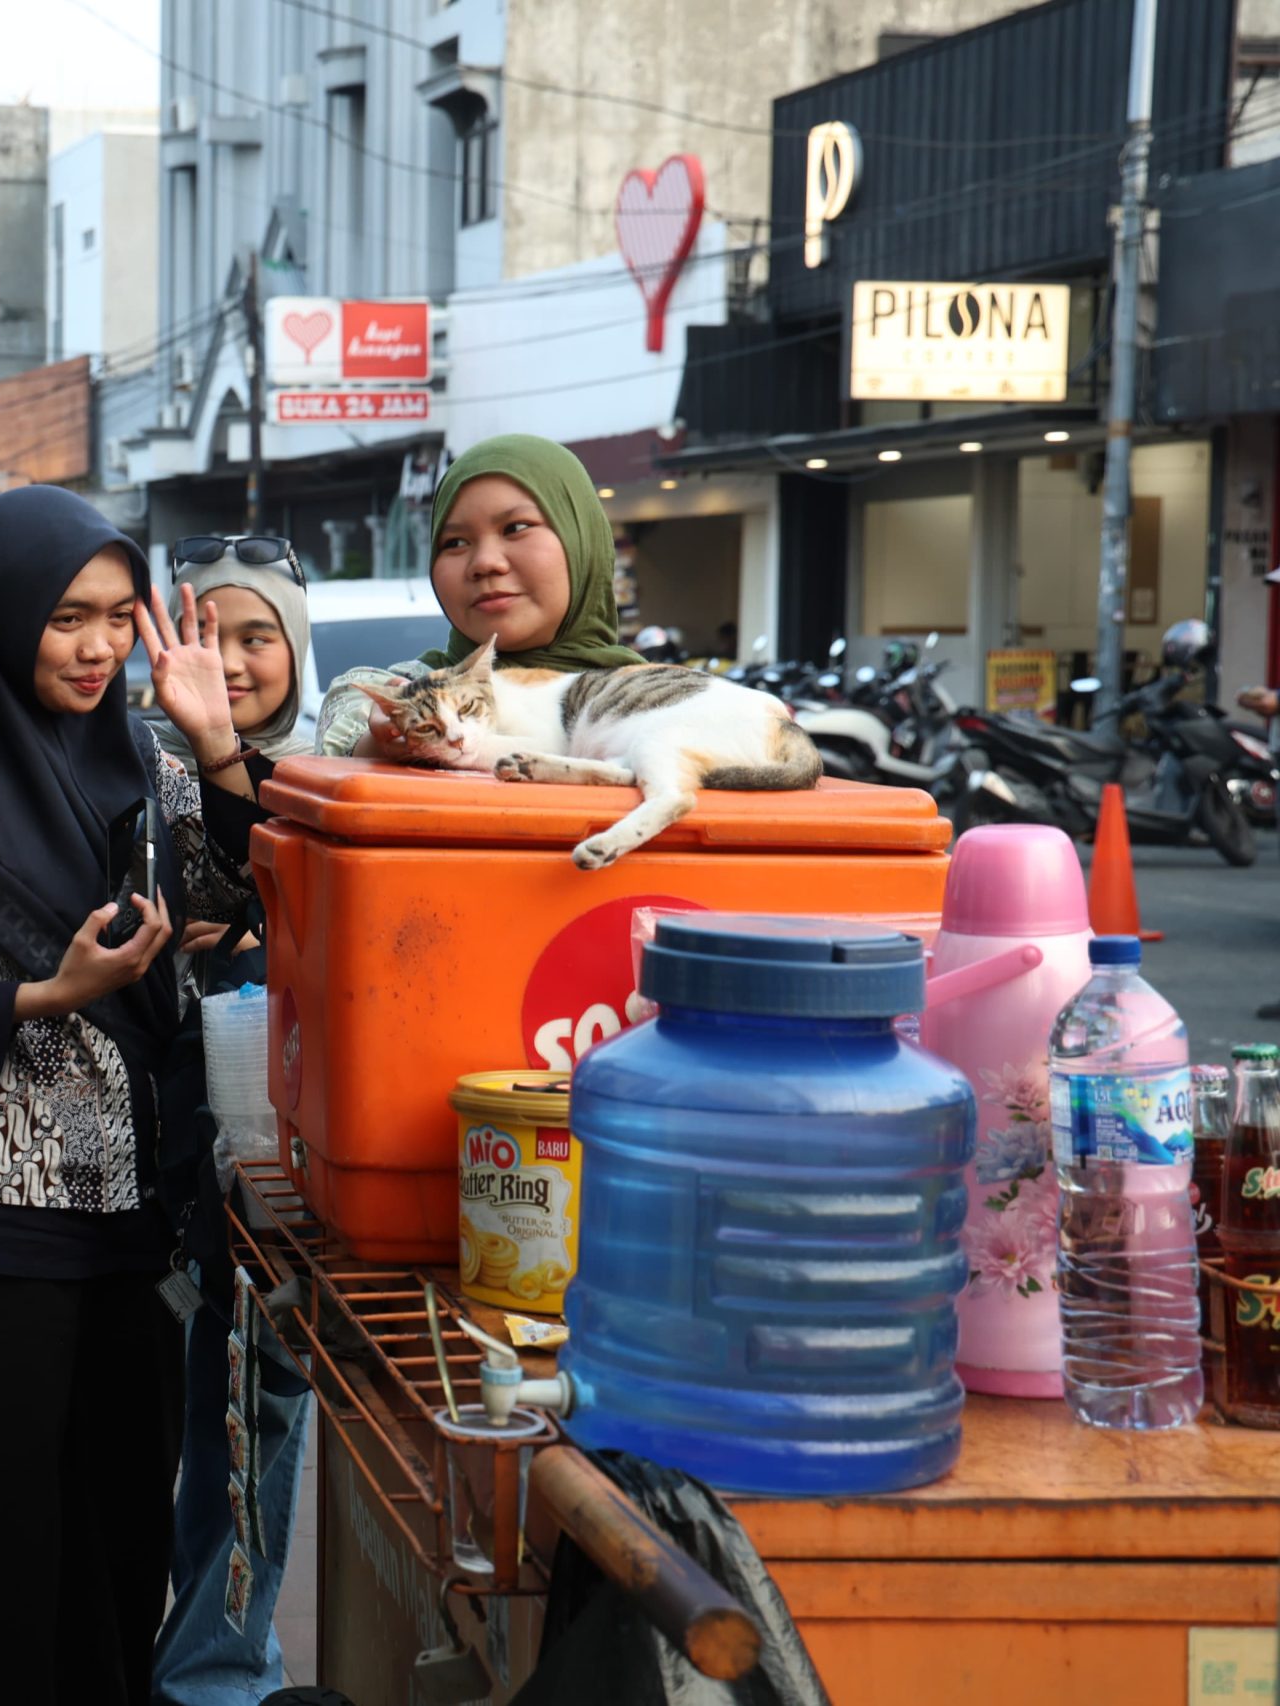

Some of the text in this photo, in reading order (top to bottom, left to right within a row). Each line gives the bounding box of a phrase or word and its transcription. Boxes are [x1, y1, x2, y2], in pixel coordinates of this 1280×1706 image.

[872, 289, 1049, 339] PILONA
[283, 396, 424, 417] BUKA 24 JAM
[537, 1140, 569, 1158] BARU
[500, 1174, 550, 1207] Ring
[502, 1214, 537, 1226] BUTTER
